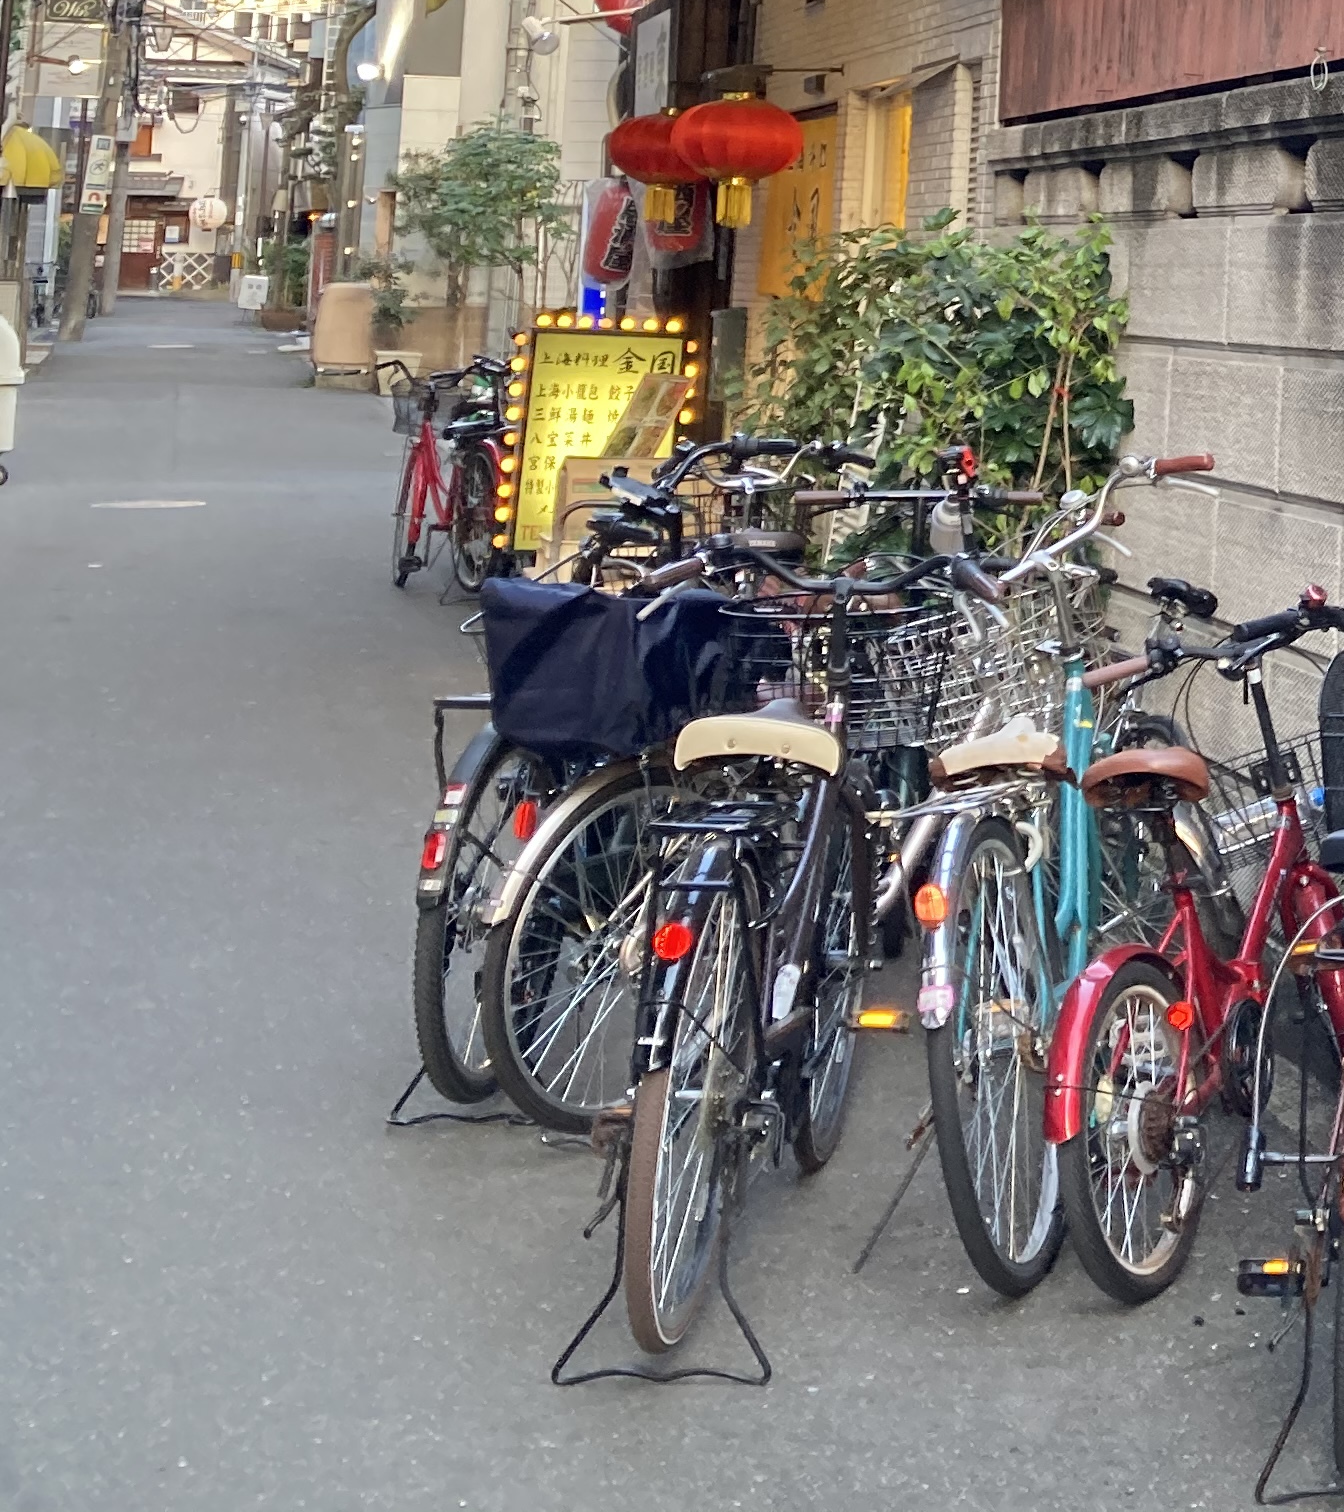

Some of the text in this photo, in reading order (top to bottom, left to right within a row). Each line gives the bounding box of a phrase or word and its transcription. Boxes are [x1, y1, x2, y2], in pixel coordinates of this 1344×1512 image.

[539, 347, 675, 375] 上海料理 金国
